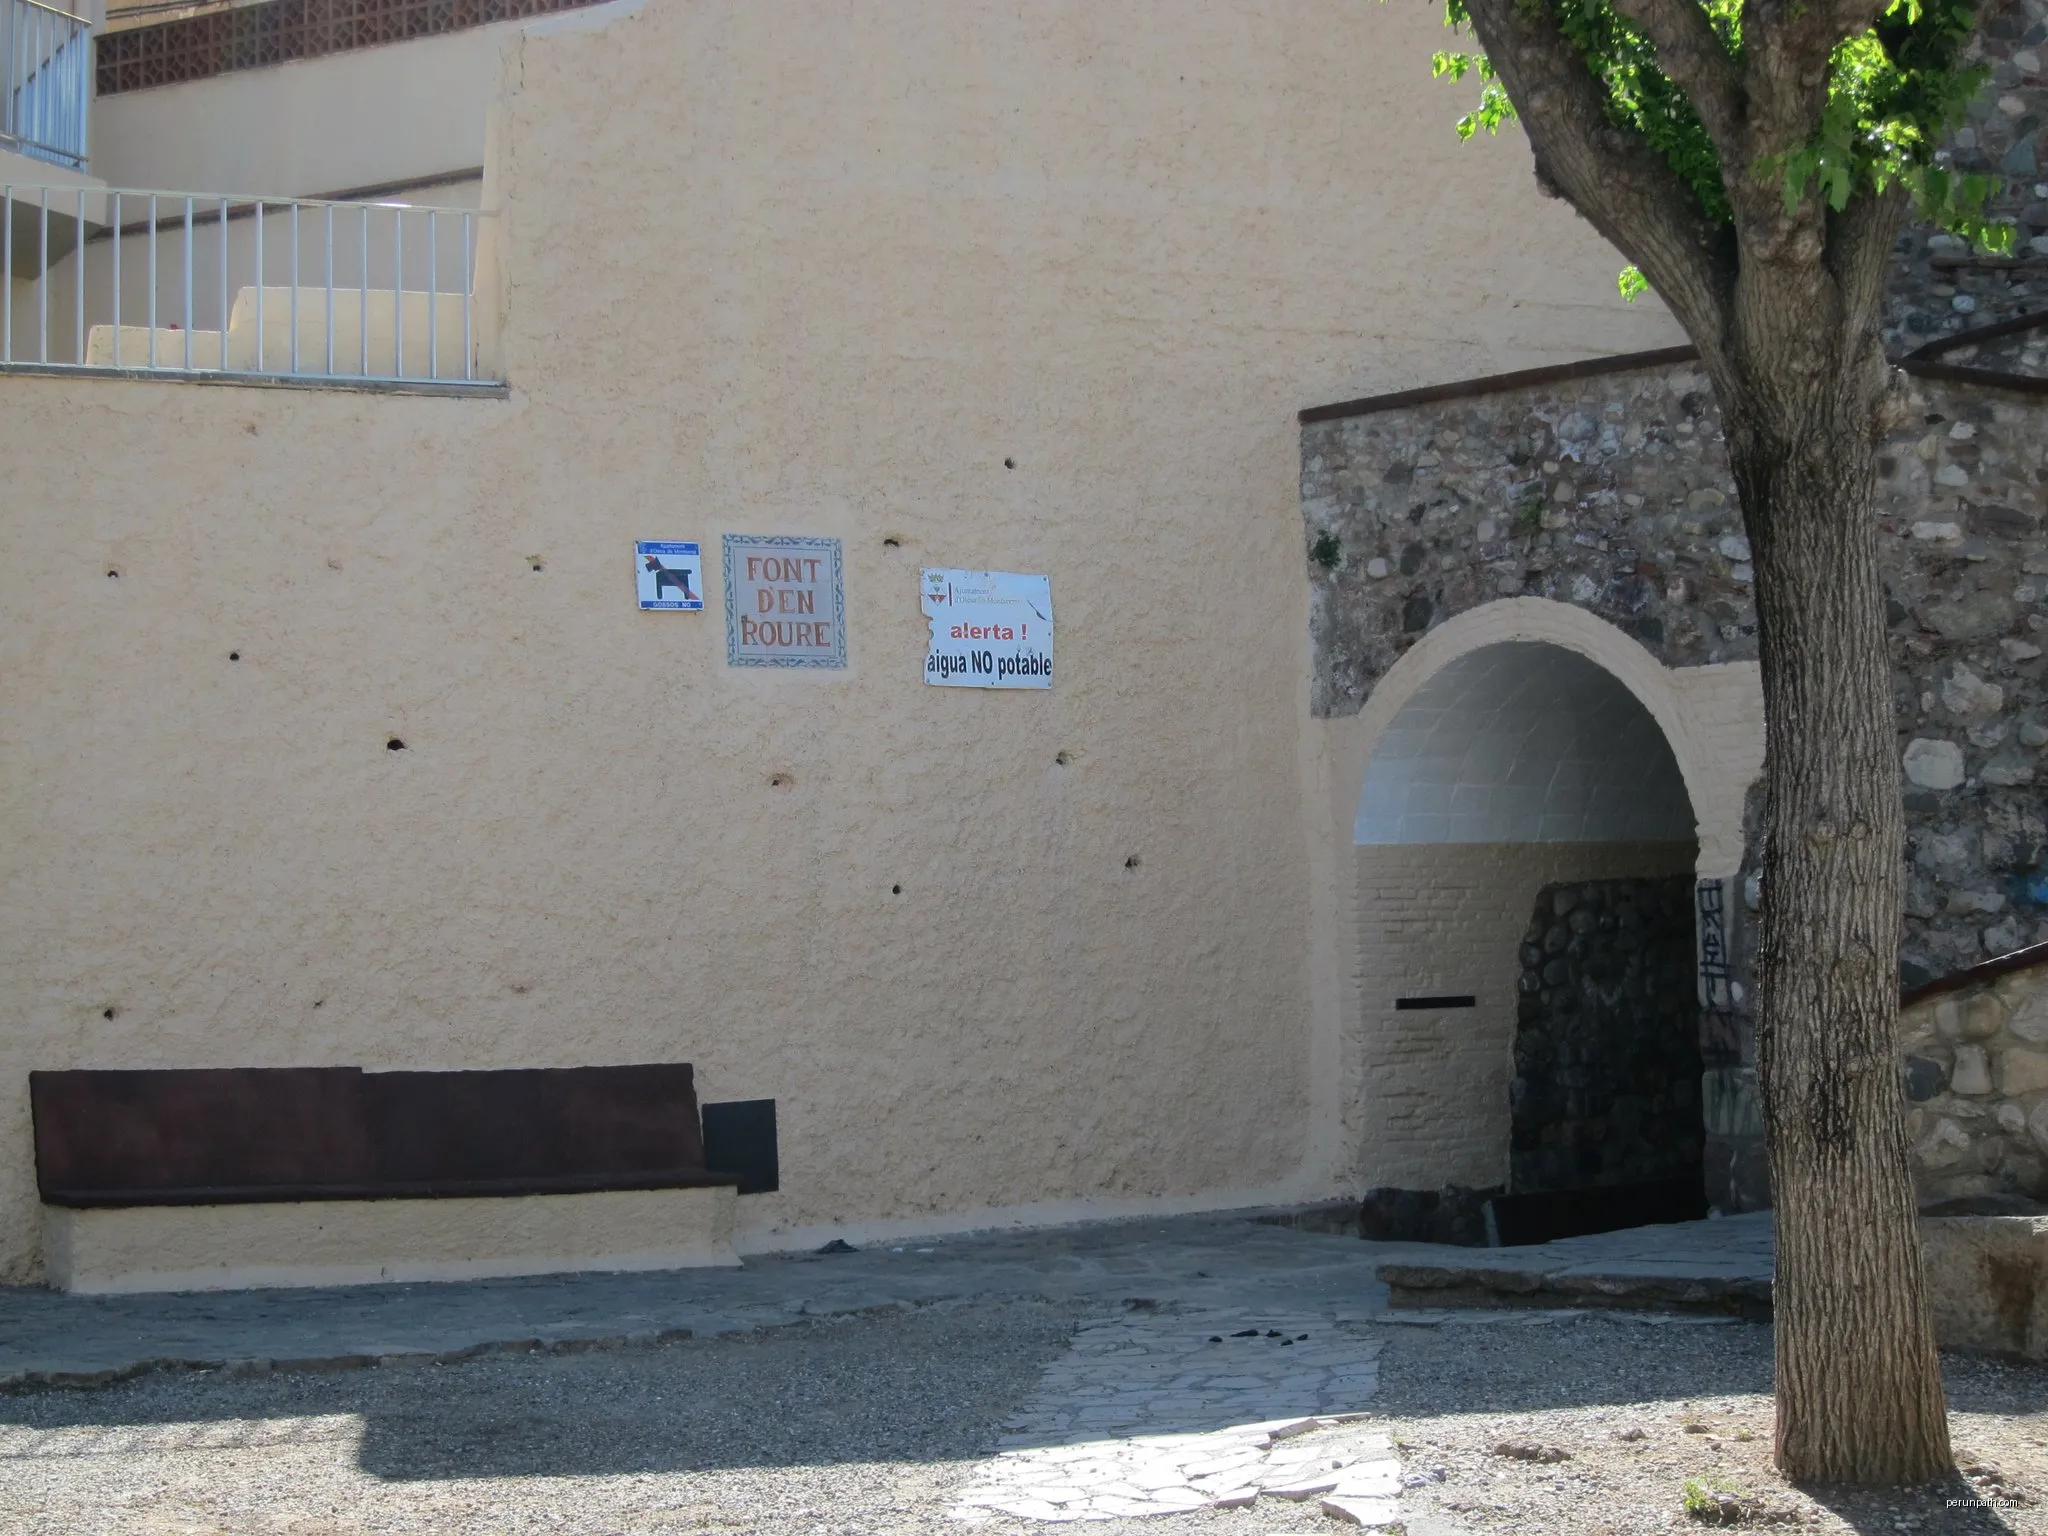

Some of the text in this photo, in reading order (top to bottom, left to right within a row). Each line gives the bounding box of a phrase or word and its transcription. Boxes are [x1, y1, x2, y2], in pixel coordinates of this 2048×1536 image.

[746, 557, 822, 583] FONT
[756, 586, 815, 614] D'EN
[741, 615, 831, 647] ROURE
[950, 622, 1014, 640] alerta
[927, 649, 1052, 680] aigua NO potable
